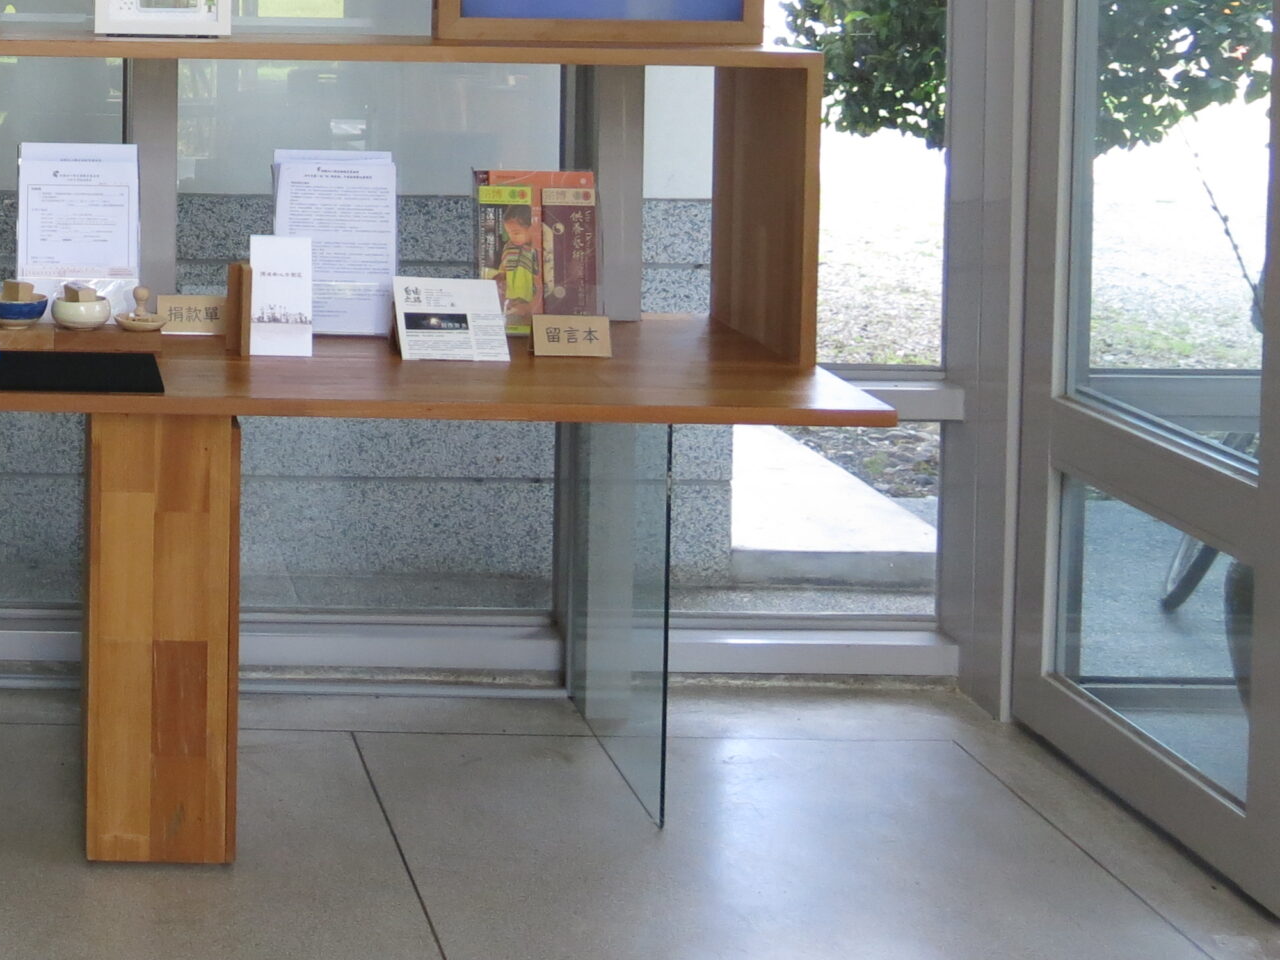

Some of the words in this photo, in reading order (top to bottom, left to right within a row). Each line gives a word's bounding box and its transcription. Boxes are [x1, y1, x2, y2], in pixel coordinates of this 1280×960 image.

[168, 305, 220, 322] 捐款單
[545, 326, 600, 344] 留言本
